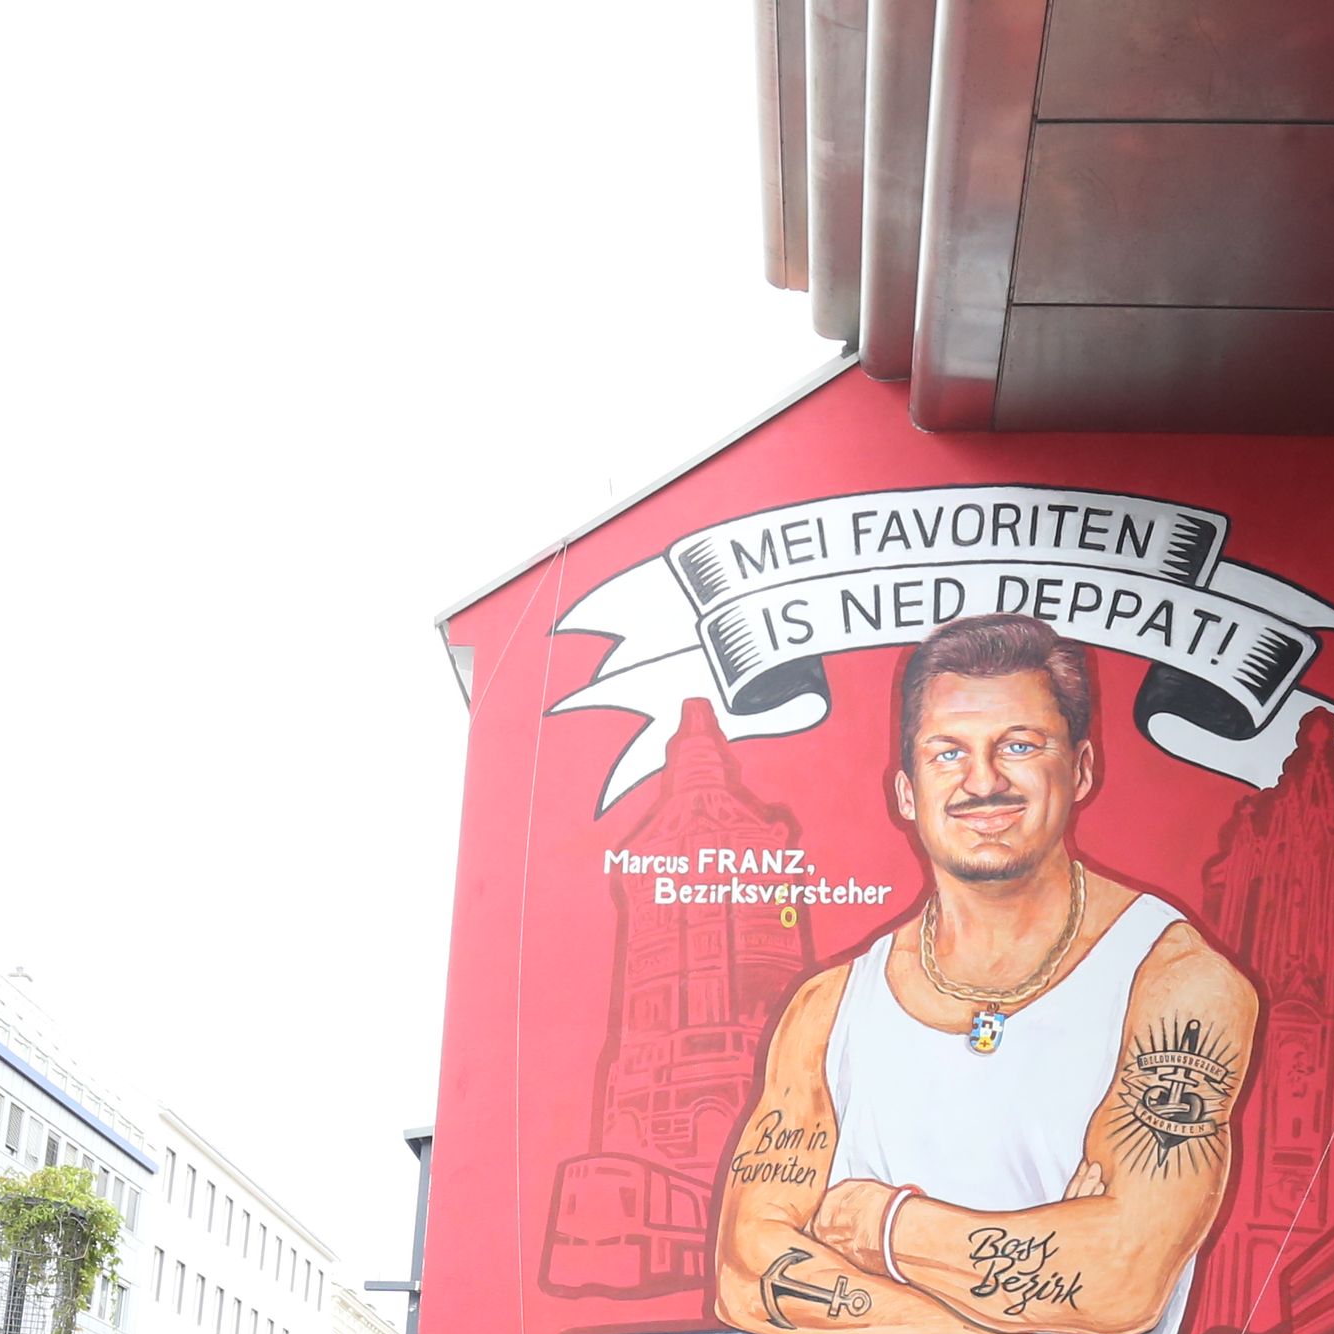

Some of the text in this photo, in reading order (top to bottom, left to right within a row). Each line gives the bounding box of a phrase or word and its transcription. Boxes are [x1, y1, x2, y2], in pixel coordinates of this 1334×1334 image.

[732, 502, 1154, 578] MEI FAVORITEN
[762, 575, 1238, 664] IS NED DEPPAT!
[603, 848, 815, 876] Marcus FRANZ,
[654, 877, 892, 905] Bezirksversteher
[755, 1109, 829, 1155] Born in
[1140, 1110, 1205, 1132] FAVORITEN
[731, 1156, 817, 1189] Favoriten
[969, 1227, 1058, 1266] Boss
[970, 1258, 1085, 1313] Bezirk
